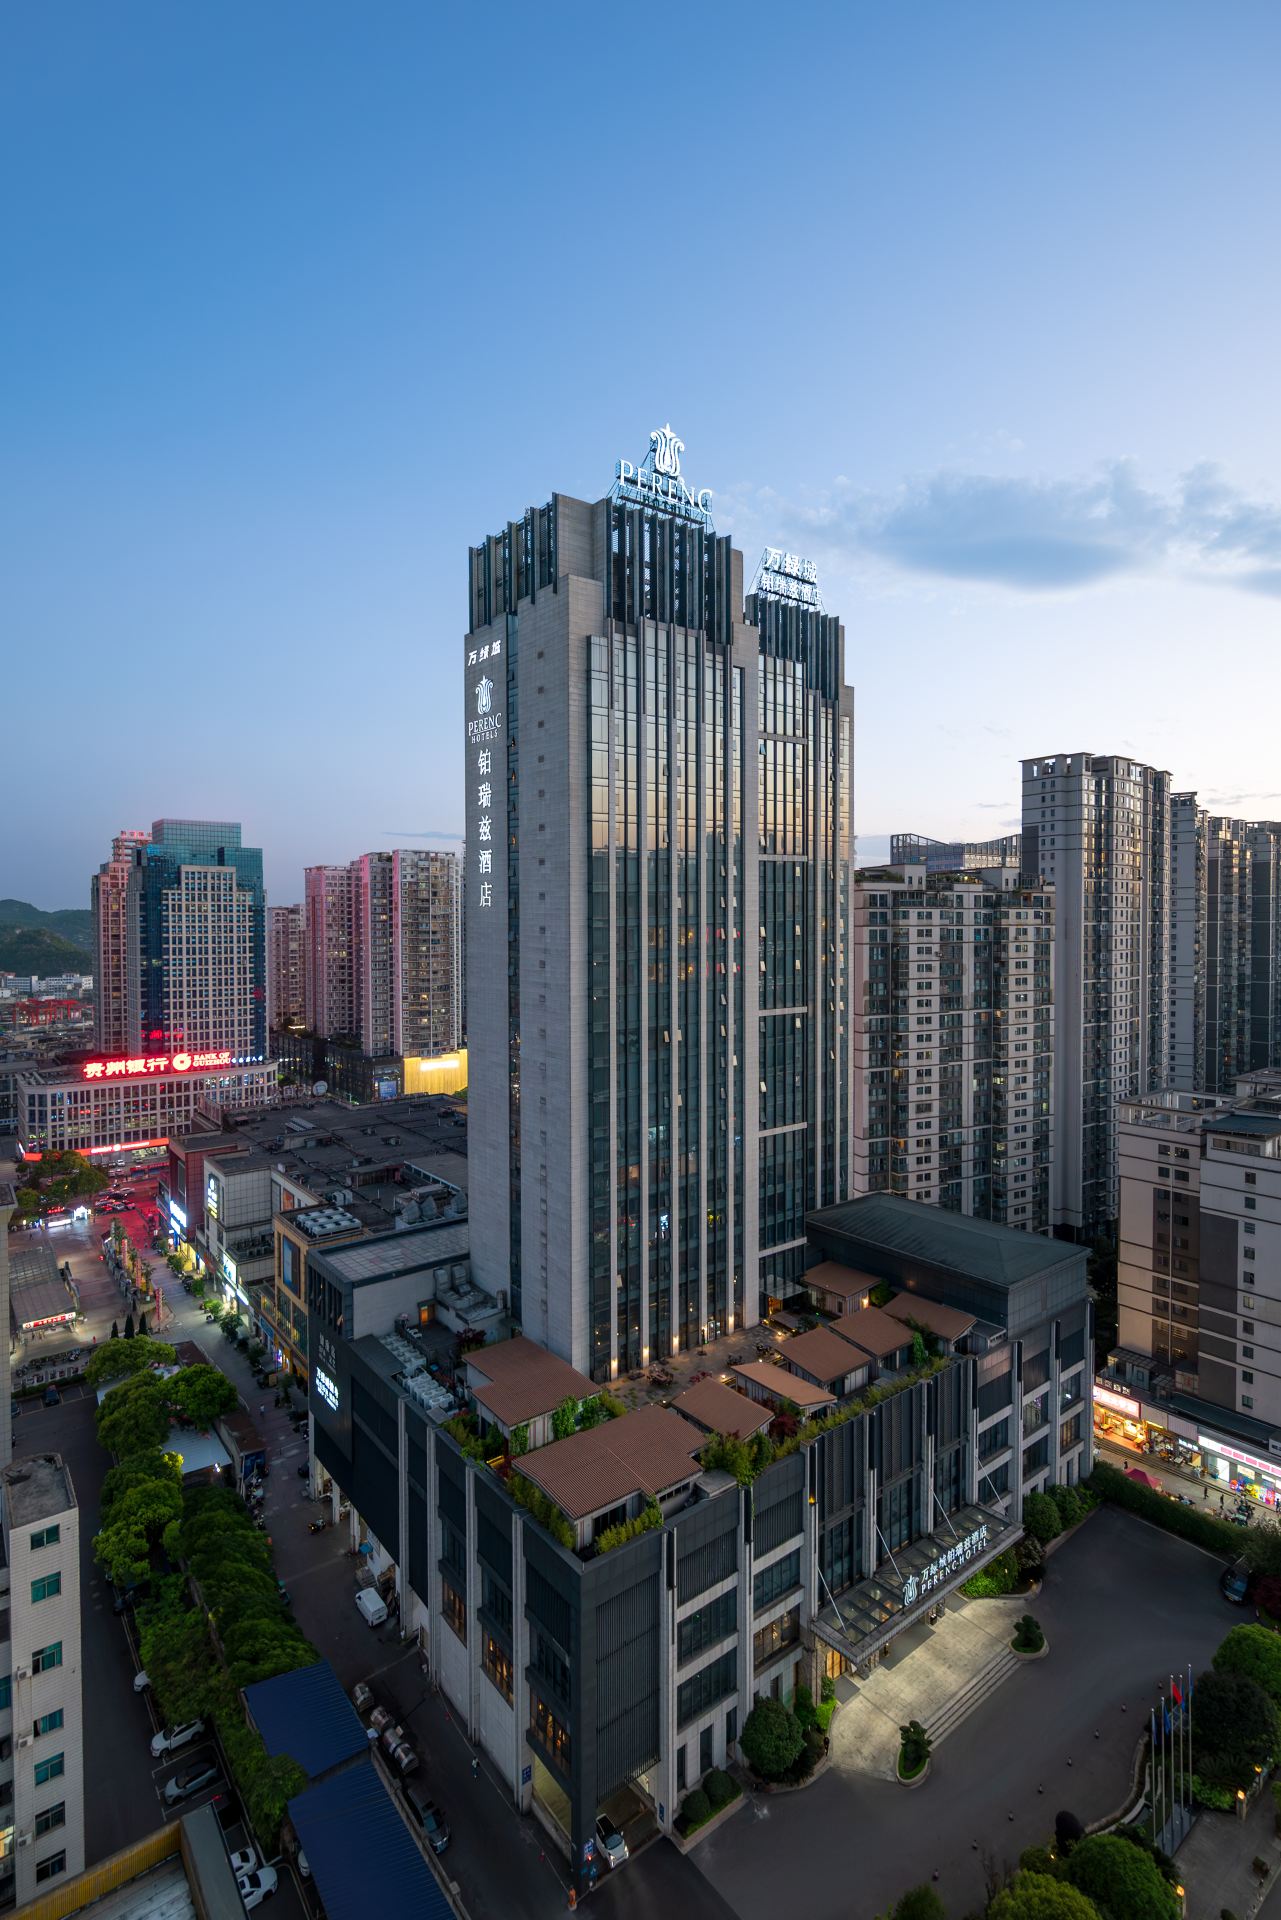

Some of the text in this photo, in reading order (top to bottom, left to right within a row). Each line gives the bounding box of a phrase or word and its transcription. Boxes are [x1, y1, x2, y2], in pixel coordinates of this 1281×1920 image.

[620, 459, 713, 515] PERENC
[763, 546, 817, 583] 万绿城
[761, 572, 822, 605] 铂瑞兹酒店
[468, 712, 502, 737] PERENC
[471, 729, 498, 744] HOTELS
[477, 747, 493, 908] 铂瑞兹酒店
[83, 1056, 170, 1079] 贵州银行
[193, 1053, 217, 1061] BANK
[193, 1057, 231, 1067] GUIZHOU
[921, 1524, 987, 1584] 万绿城铂瑞兹酒店
